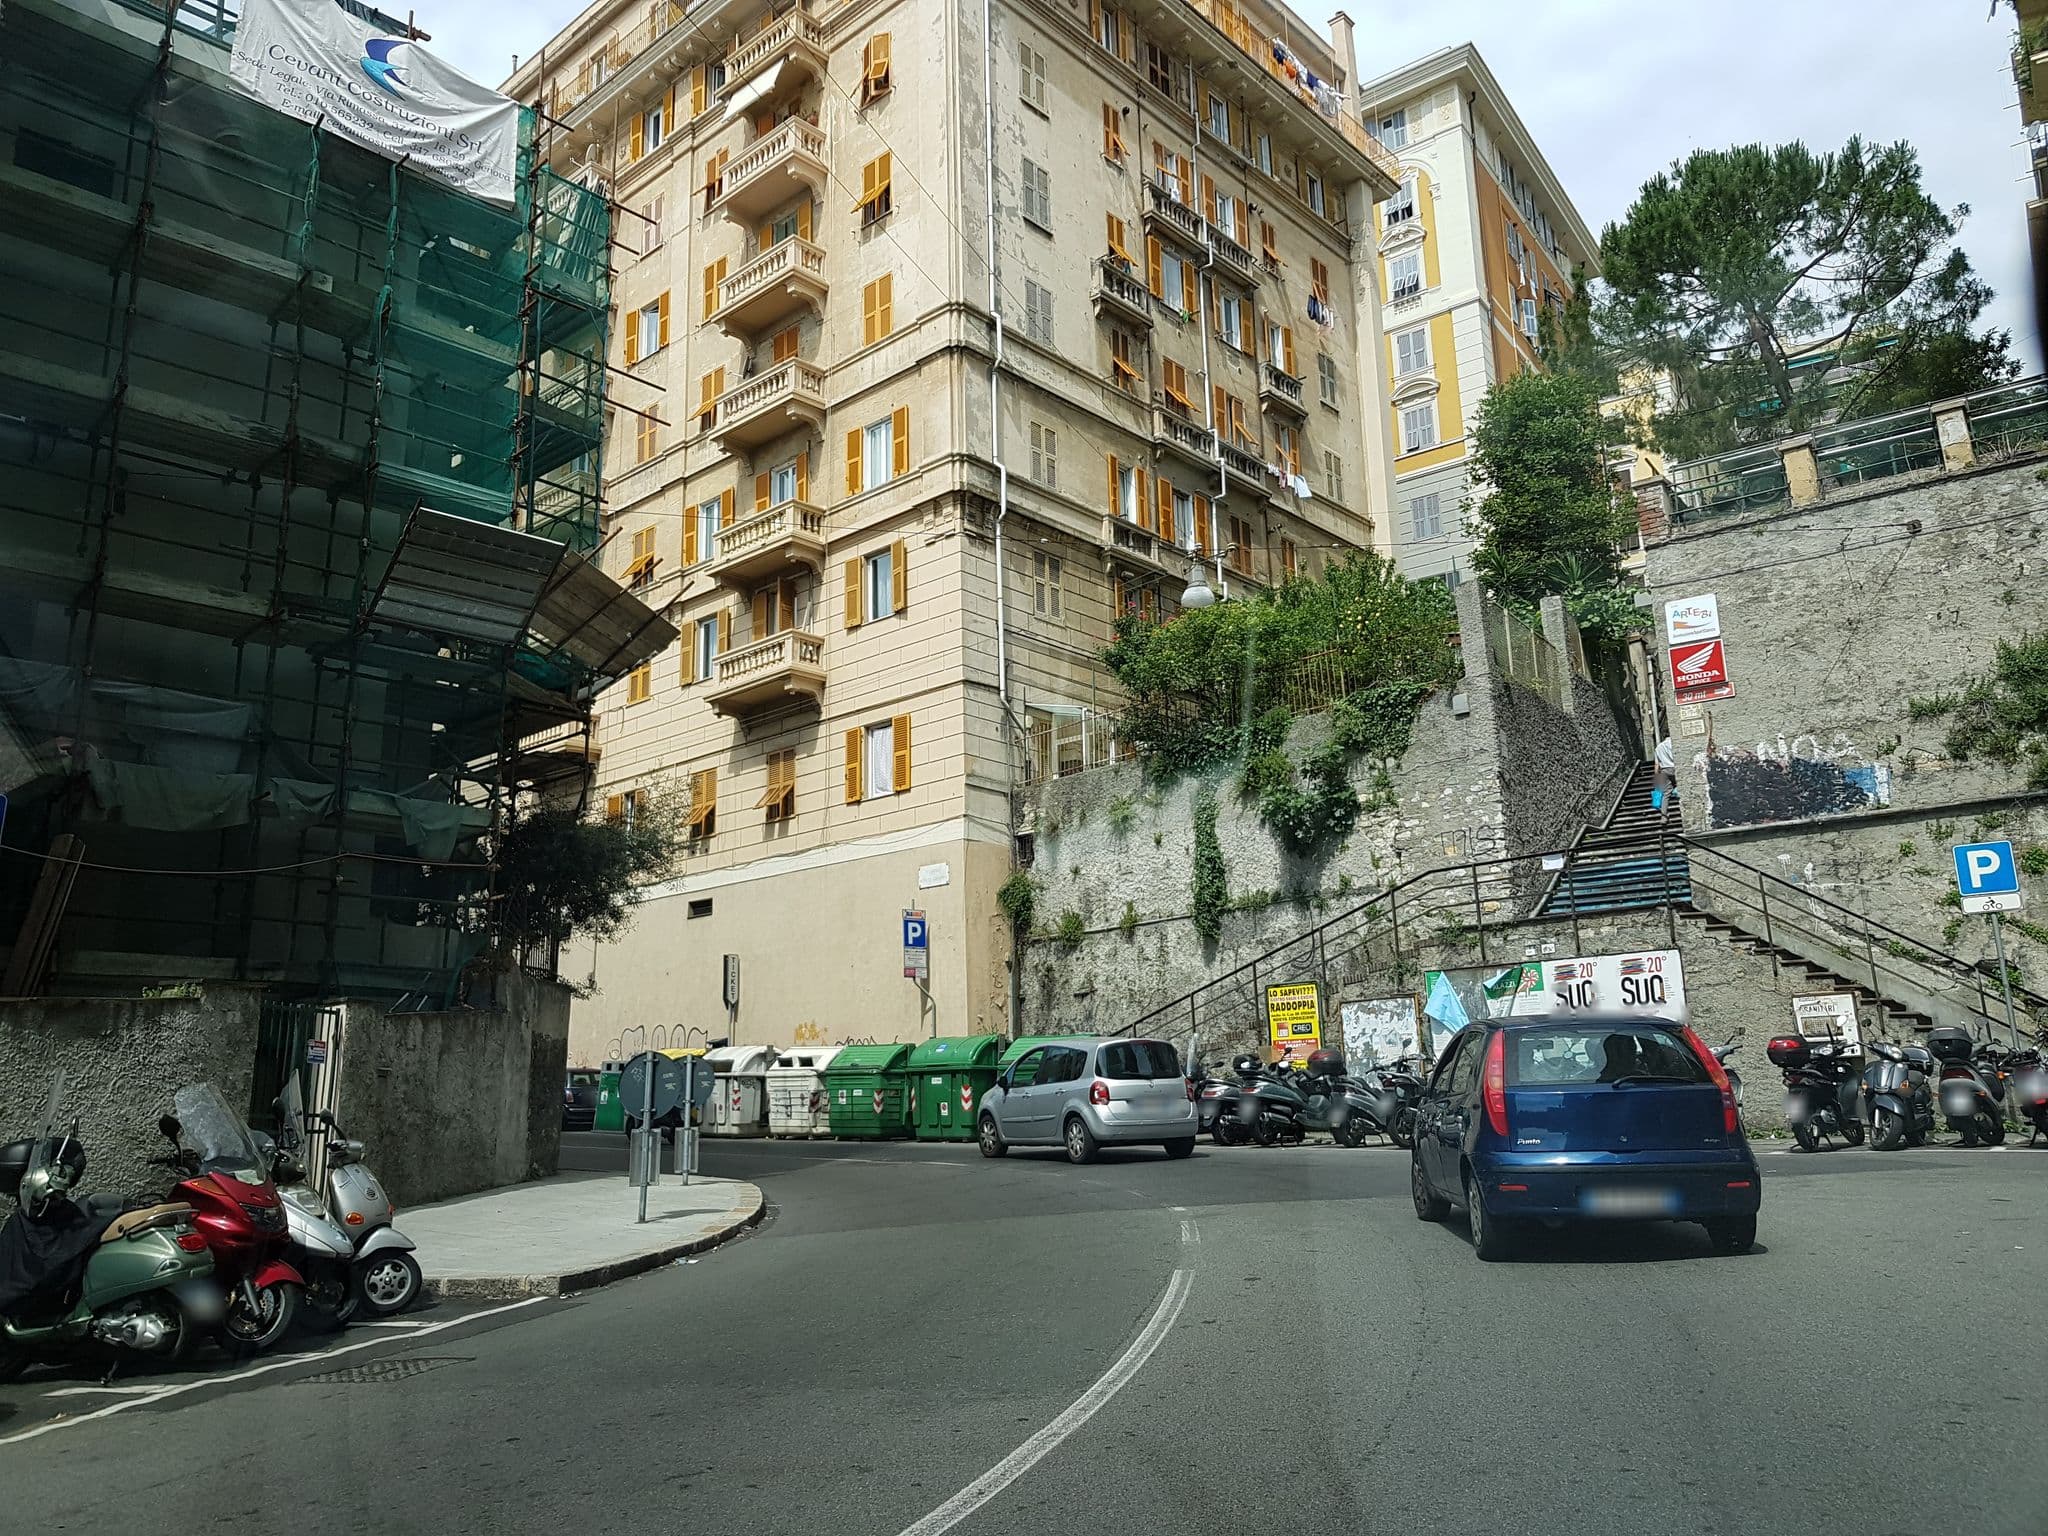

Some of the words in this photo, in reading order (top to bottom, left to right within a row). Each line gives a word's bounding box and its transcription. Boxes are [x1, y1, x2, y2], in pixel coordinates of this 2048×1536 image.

[268, 44, 343, 88] Cevani
[348, 81, 456, 141] Costruzioni
[457, 133, 482, 155] Srl
[316, 85, 336, 100] Via
[434, 141, 466, 160] 16129
[330, 105, 375, 131] 565232
[410, 142, 429, 156] 347
[1677, 669, 1721, 682] HONDA
[1682, 692, 1693, 701] 30
[1966, 849, 2001, 888] P
[907, 921, 922, 945] P
[1269, 990, 1278, 998] LO
[1280, 986, 1314, 997] SAPEVI???
[1621, 974, 1667, 1006] SUQ
[1270, 1000, 1315, 1012] RADDOPPIA
